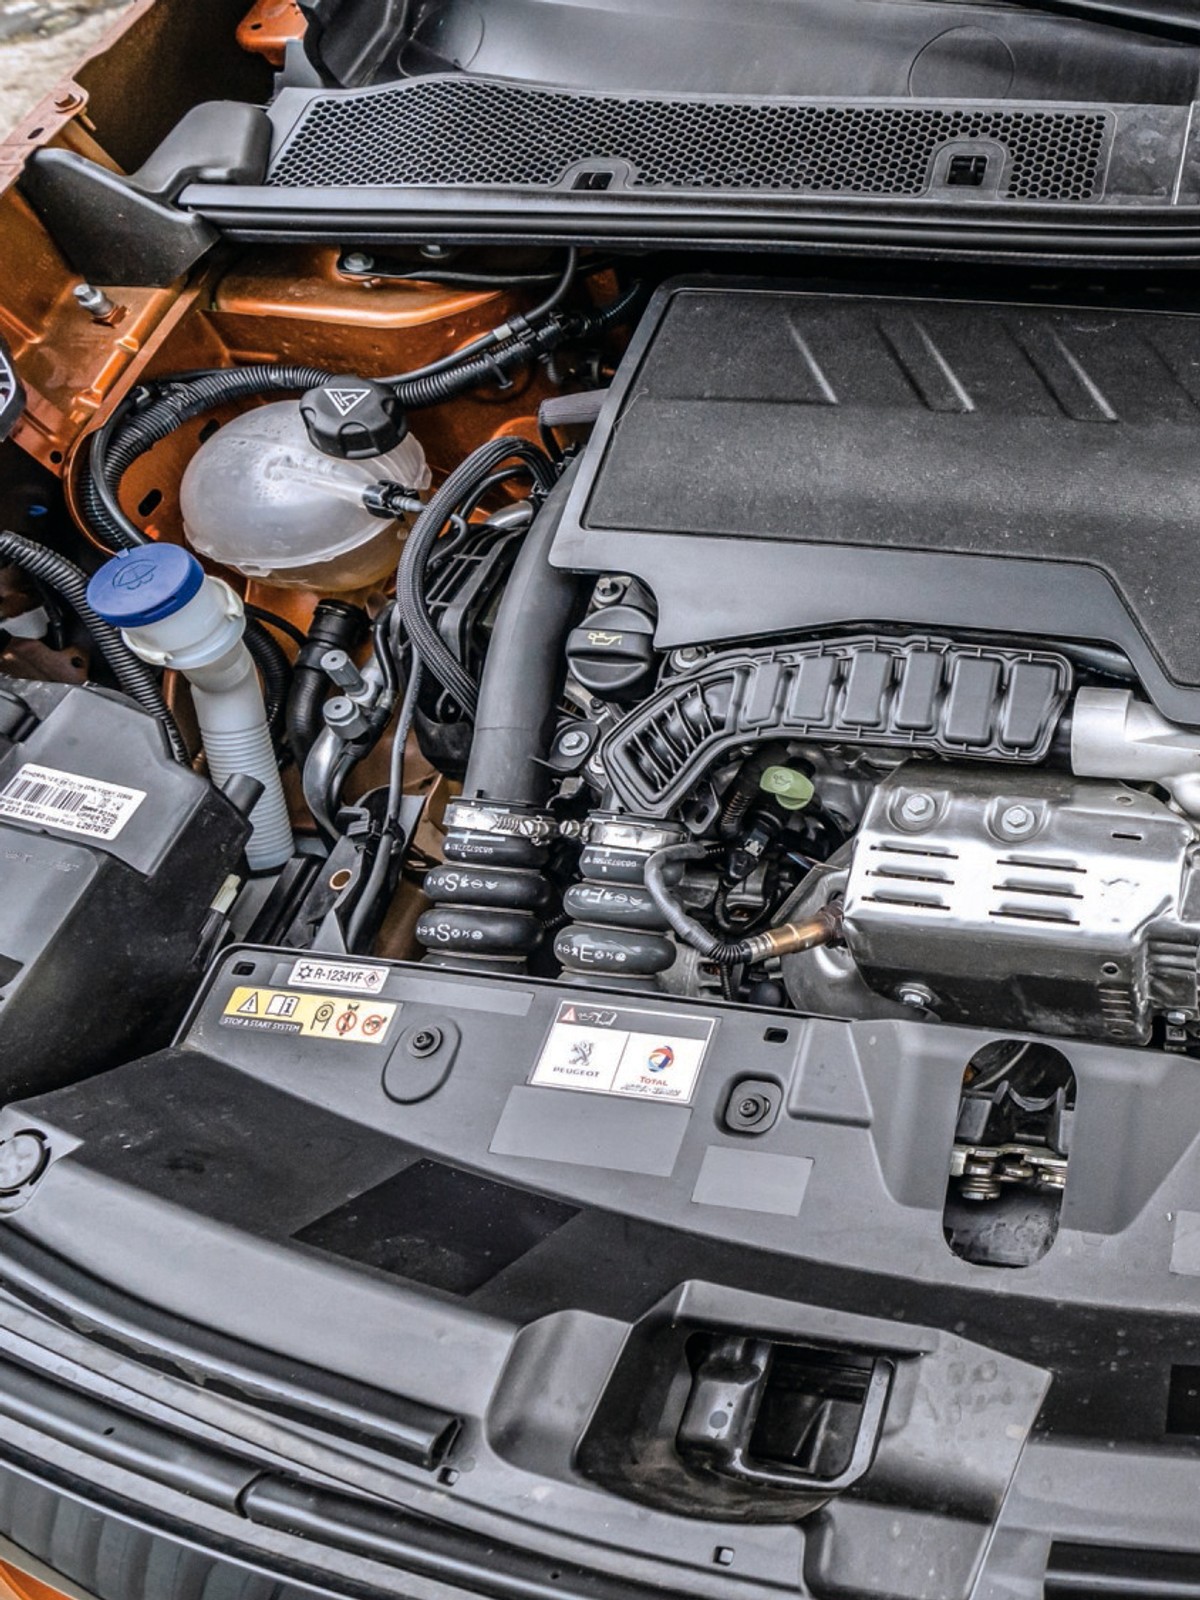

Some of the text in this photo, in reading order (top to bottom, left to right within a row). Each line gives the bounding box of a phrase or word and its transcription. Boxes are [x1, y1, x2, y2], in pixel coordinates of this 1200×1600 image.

[314, 967, 363, 983] R-1234YF
[224, 1017, 243, 1025] STOP
[249, 1020, 272, 1028] START
[272, 1023, 300, 1032] SYSTEM
[553, 1066, 600, 1078] PEUGEOT
[640, 1076, 668, 1087] TOTAL
